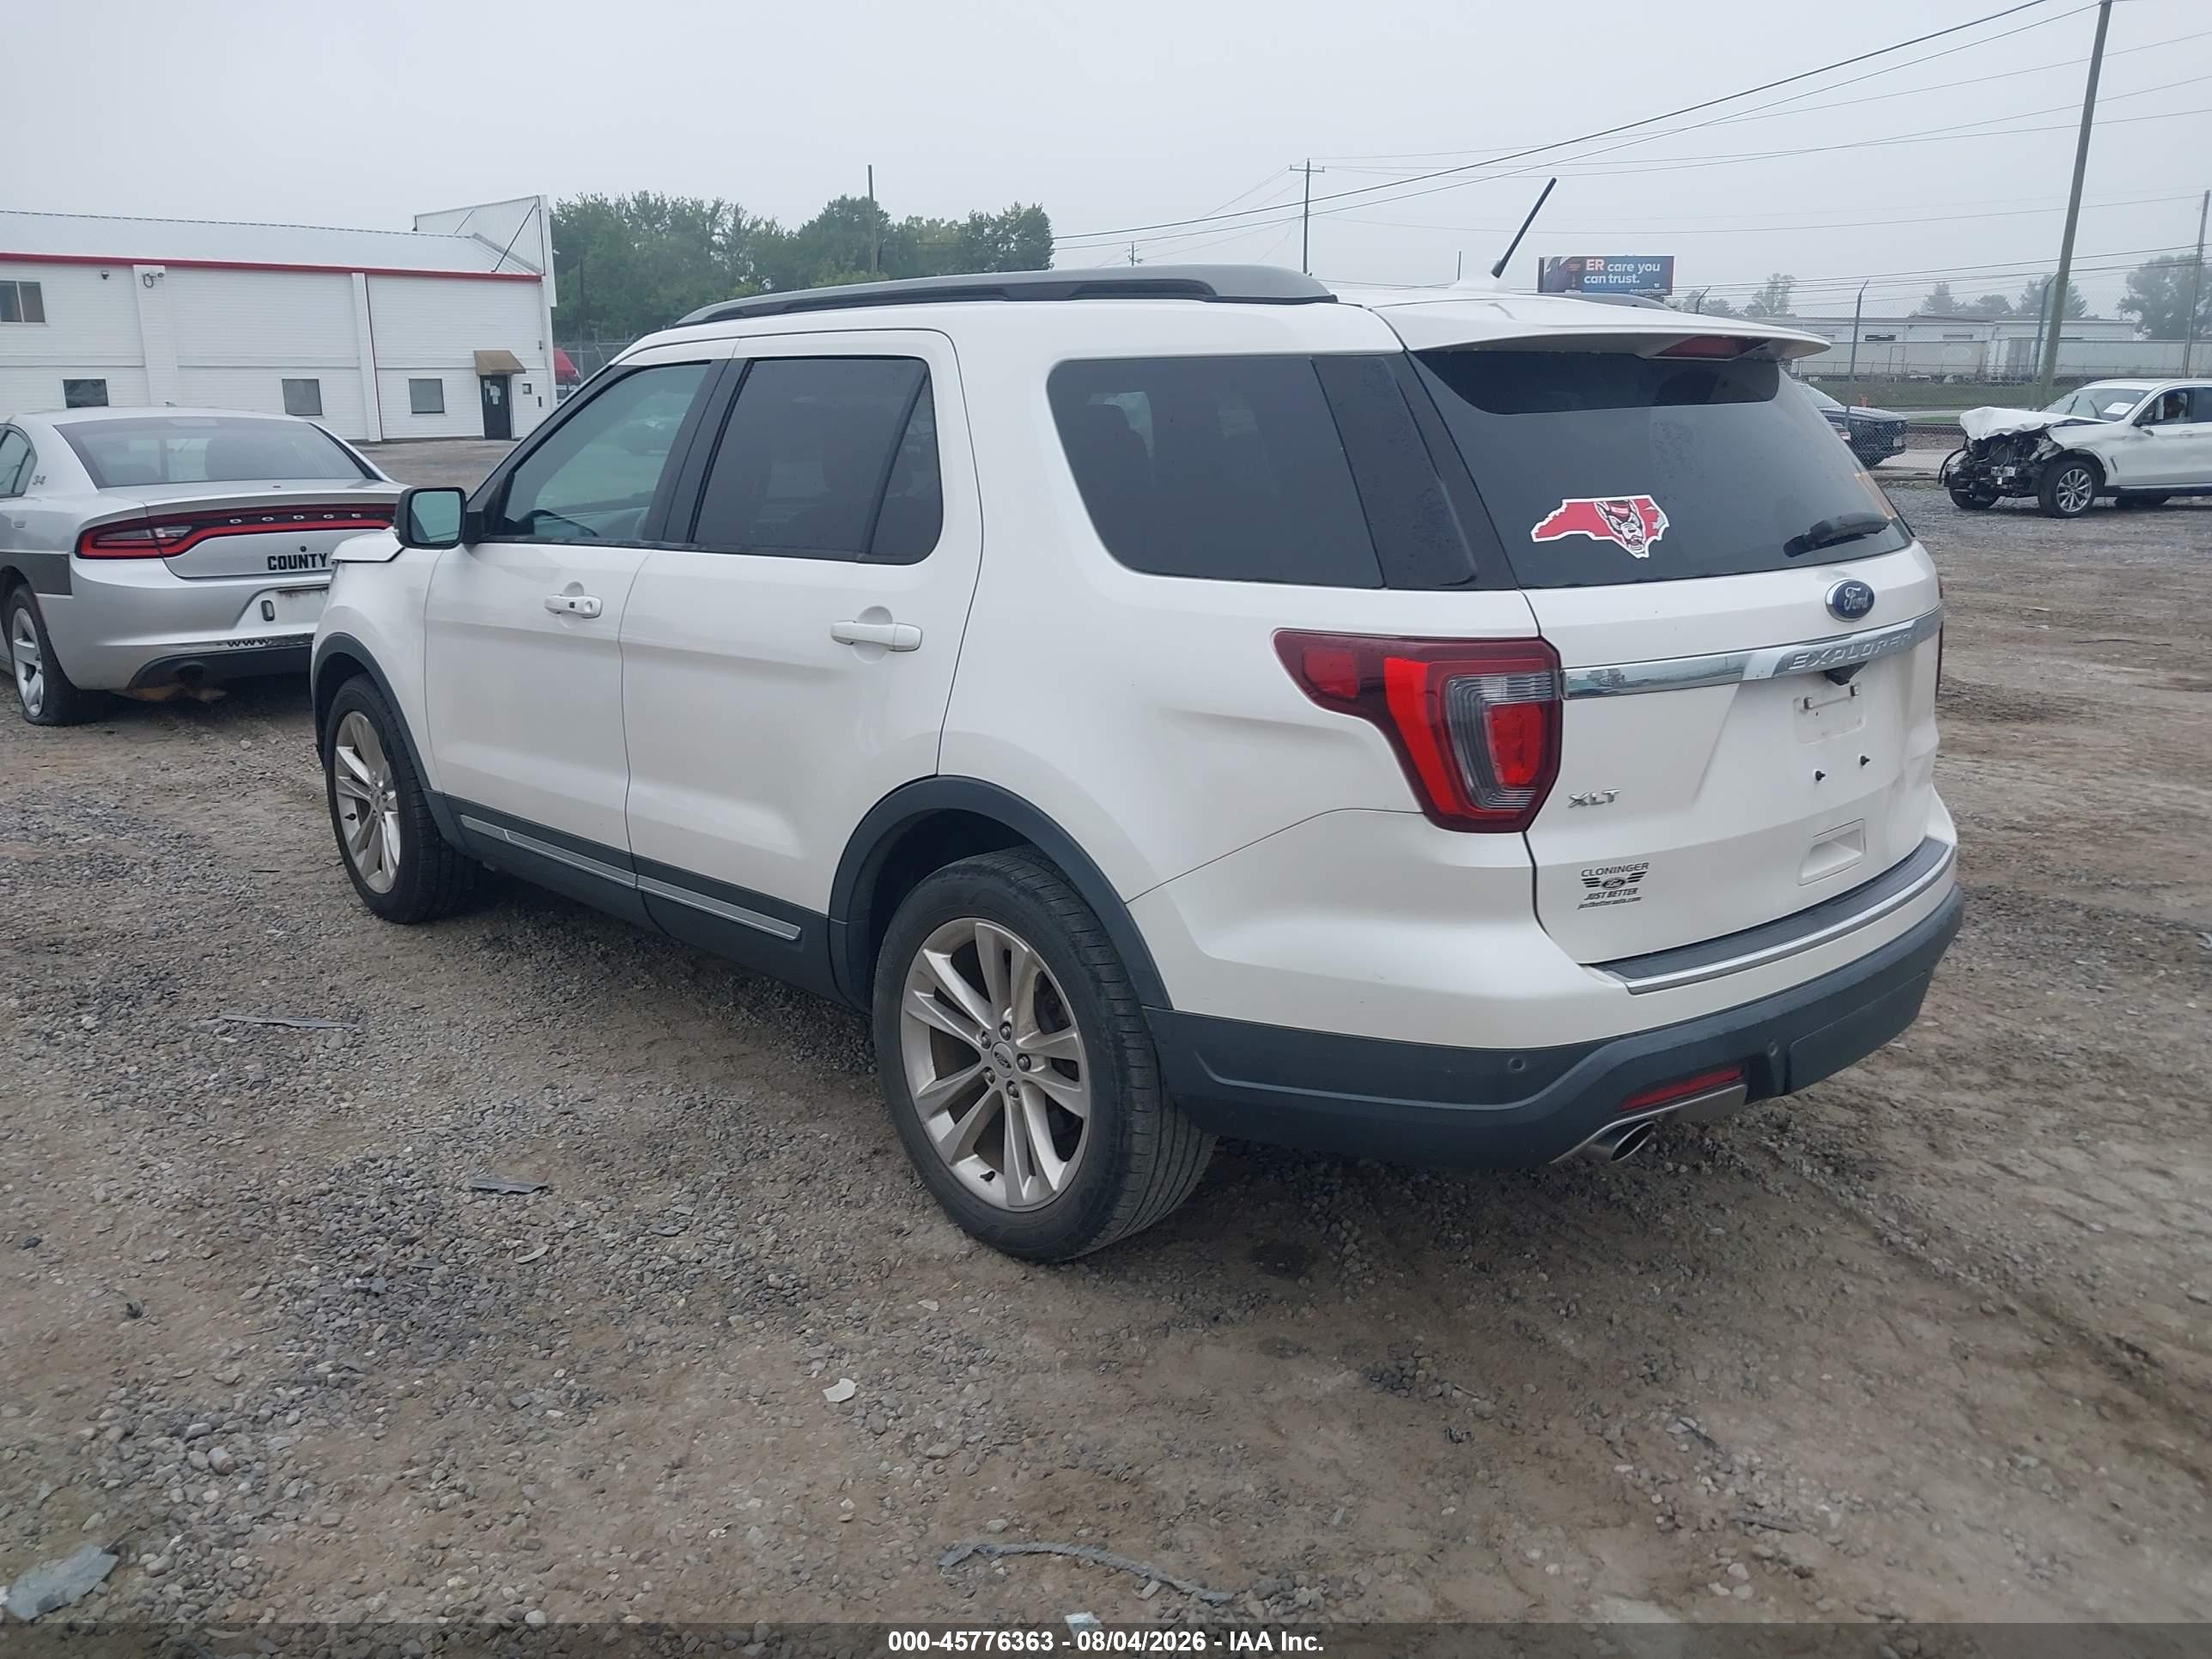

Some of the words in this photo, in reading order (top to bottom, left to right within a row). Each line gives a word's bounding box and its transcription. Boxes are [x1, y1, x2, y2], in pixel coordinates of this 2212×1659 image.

[1586, 259, 1605, 270] ER
[1607, 264, 1634, 272] care
[1638, 263, 1661, 274] you
[1583, 275, 1606, 283] can
[1607, 274, 1640, 283] trust.
[229, 513, 362, 525] DODGE
[267, 552, 328, 571] COUNTY
[1844, 586, 1869, 611] Ford
[1788, 632, 1912, 671] EXPLORER
[1568, 789, 1621, 808] XLT
[1581, 862, 1650, 878] CLONINGER
[1607, 888, 1638, 898] BETTER
